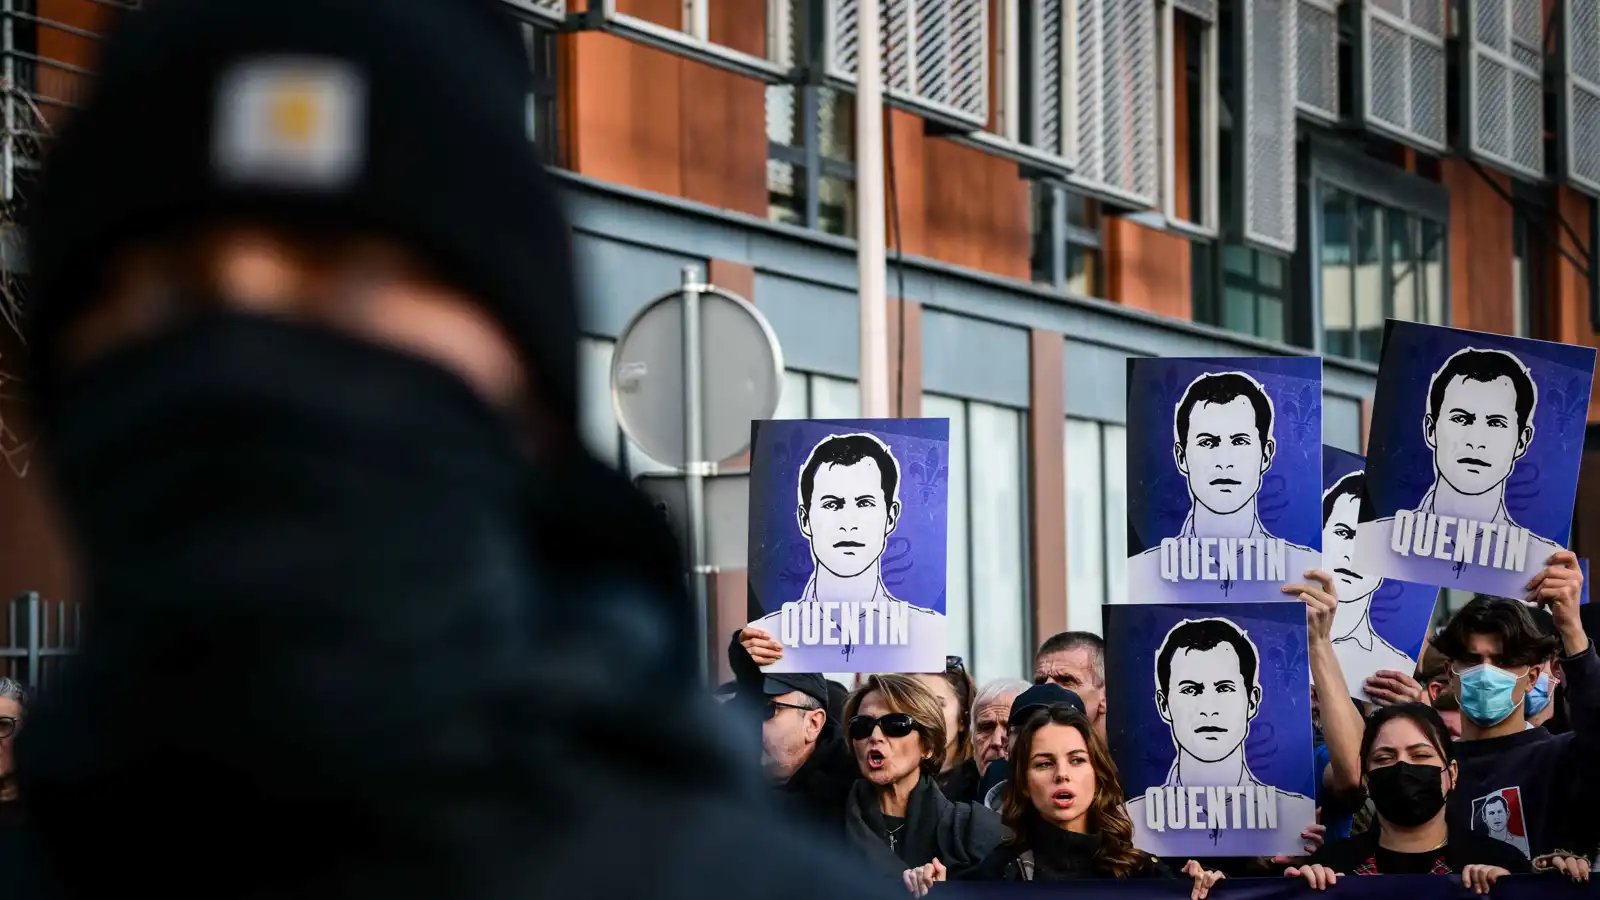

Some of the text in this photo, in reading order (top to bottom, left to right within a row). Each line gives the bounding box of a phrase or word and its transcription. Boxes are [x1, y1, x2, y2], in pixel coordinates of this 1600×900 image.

[1160, 537, 1286, 582] QUENTIN
[1391, 509, 1529, 572] QUENTIN
[781, 601, 909, 648] QUENTIN
[1145, 786, 1278, 832] QUENTIN
